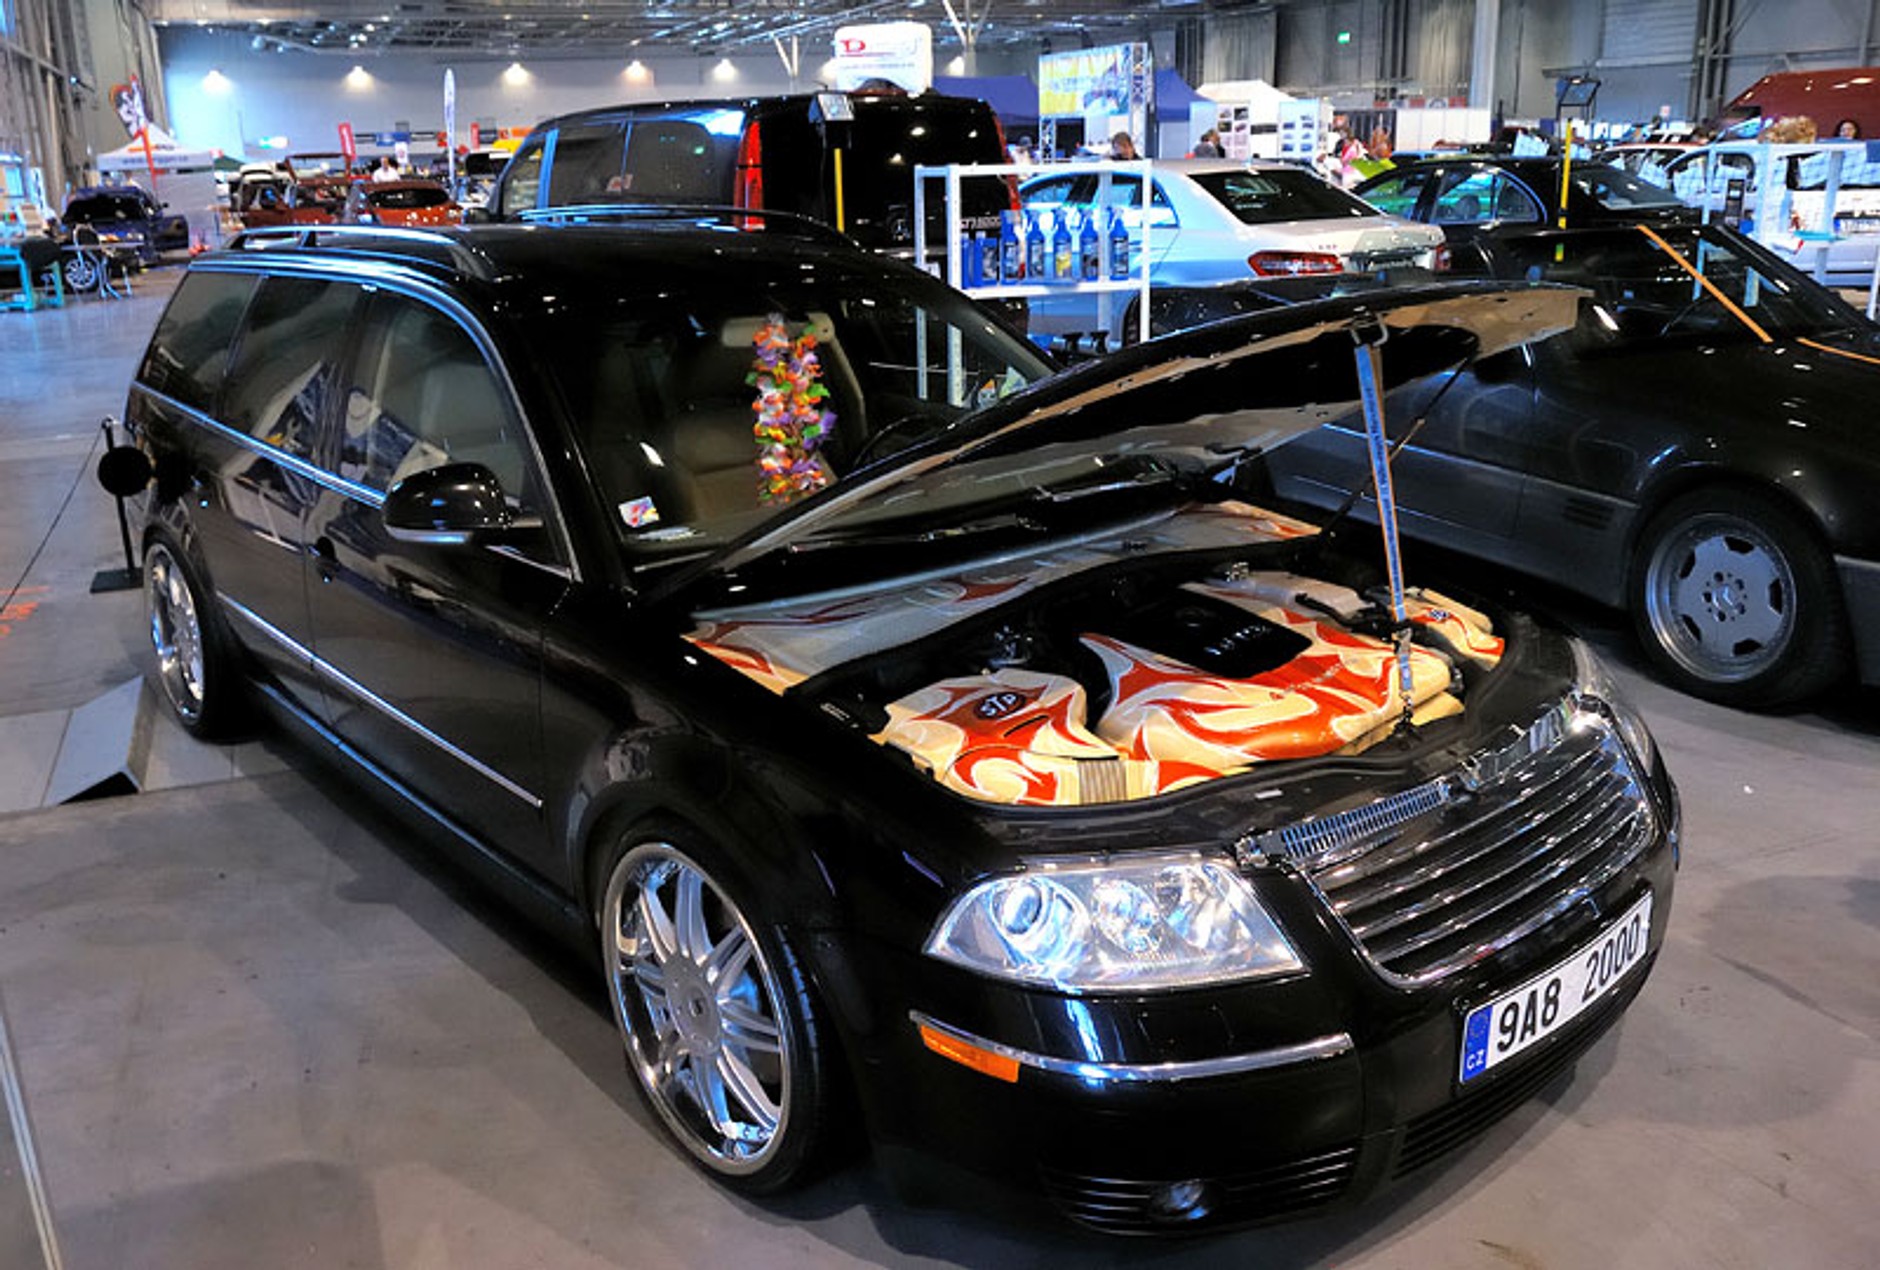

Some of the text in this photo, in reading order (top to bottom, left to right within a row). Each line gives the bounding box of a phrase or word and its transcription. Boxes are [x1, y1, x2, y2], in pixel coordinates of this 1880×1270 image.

[980, 693, 1018, 717] STP
[1497, 912, 1641, 1052] 9A8 2000
[1465, 1049, 1485, 1070] CZ
